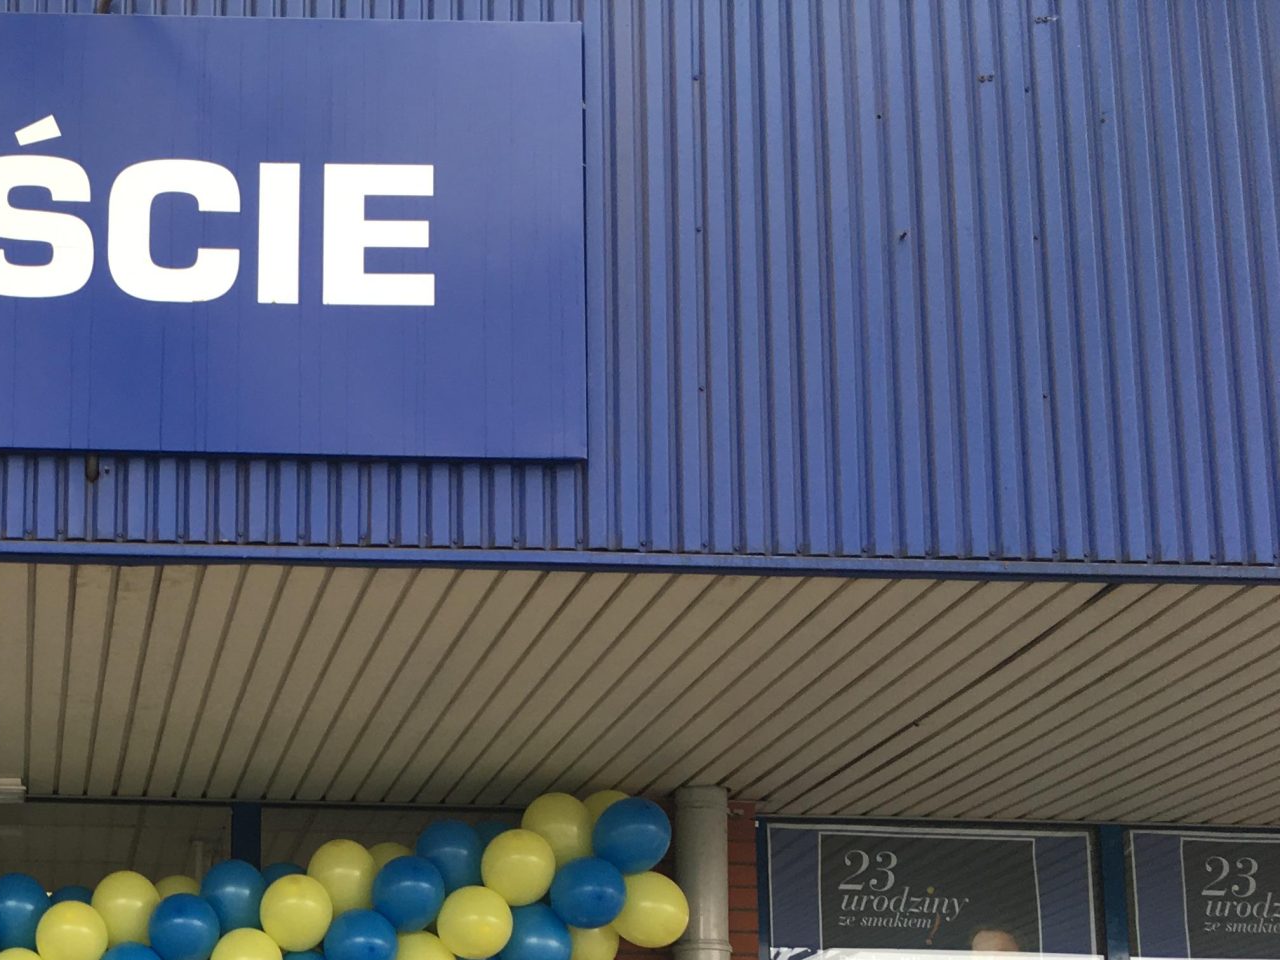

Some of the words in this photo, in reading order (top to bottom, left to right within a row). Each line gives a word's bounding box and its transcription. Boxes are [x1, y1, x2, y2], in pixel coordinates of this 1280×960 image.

[838, 850, 898, 892] 23
[1201, 856, 1259, 898] 23
[838, 915, 855, 926] ze
[840, 886, 969, 922] urodziny
[1204, 921, 1220, 932] ze
